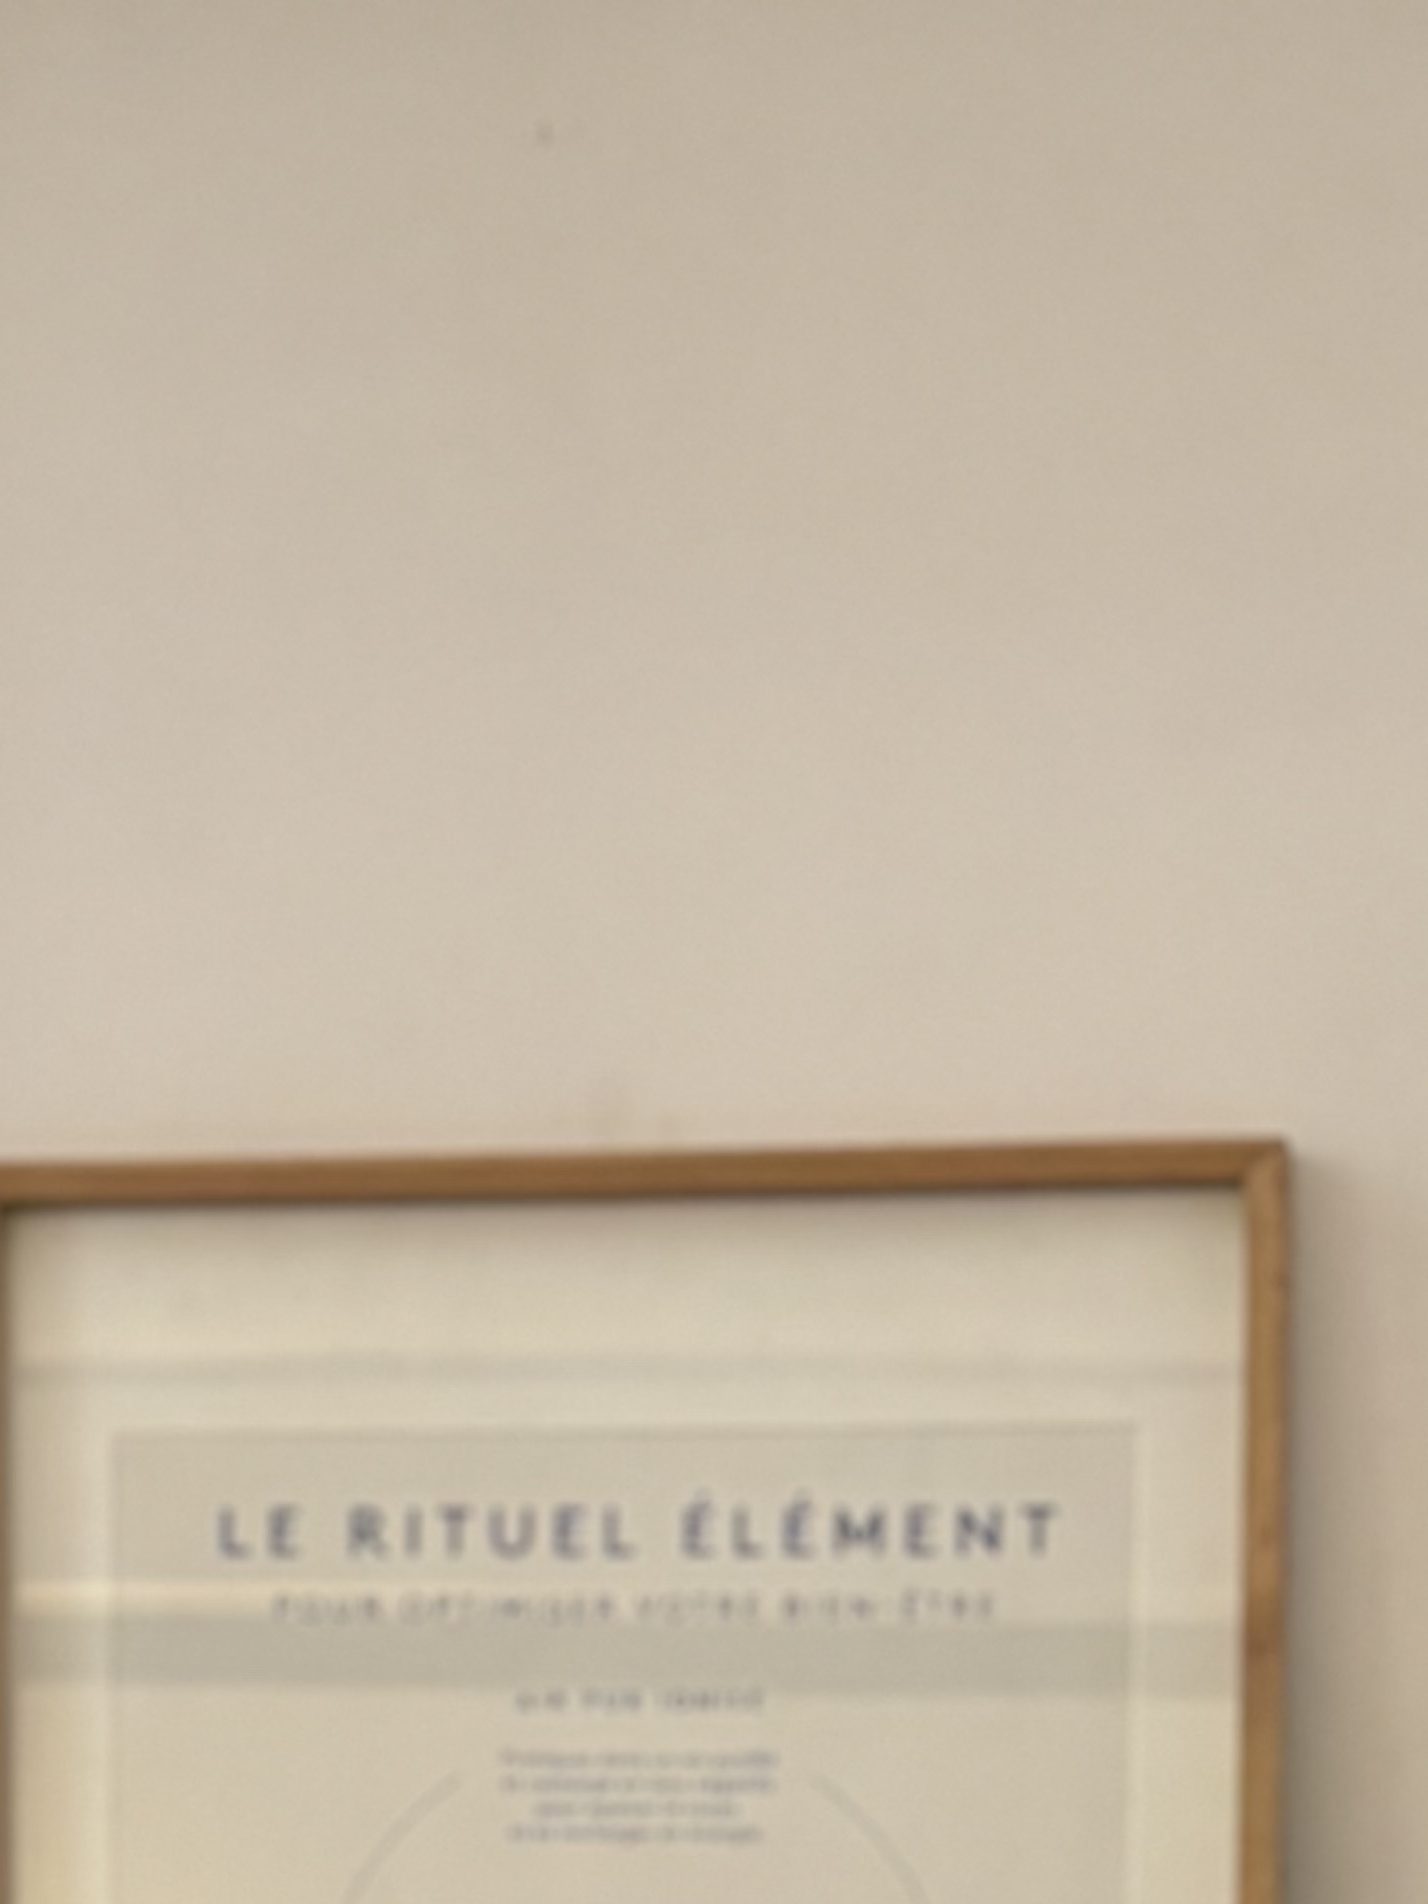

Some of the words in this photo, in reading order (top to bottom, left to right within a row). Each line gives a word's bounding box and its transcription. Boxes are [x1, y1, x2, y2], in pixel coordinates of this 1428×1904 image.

[215, 1501, 302, 1561] LE
[344, 1501, 636, 1561] RITUEL
[678, 1488, 1060, 1561] ÉLÉMENT
